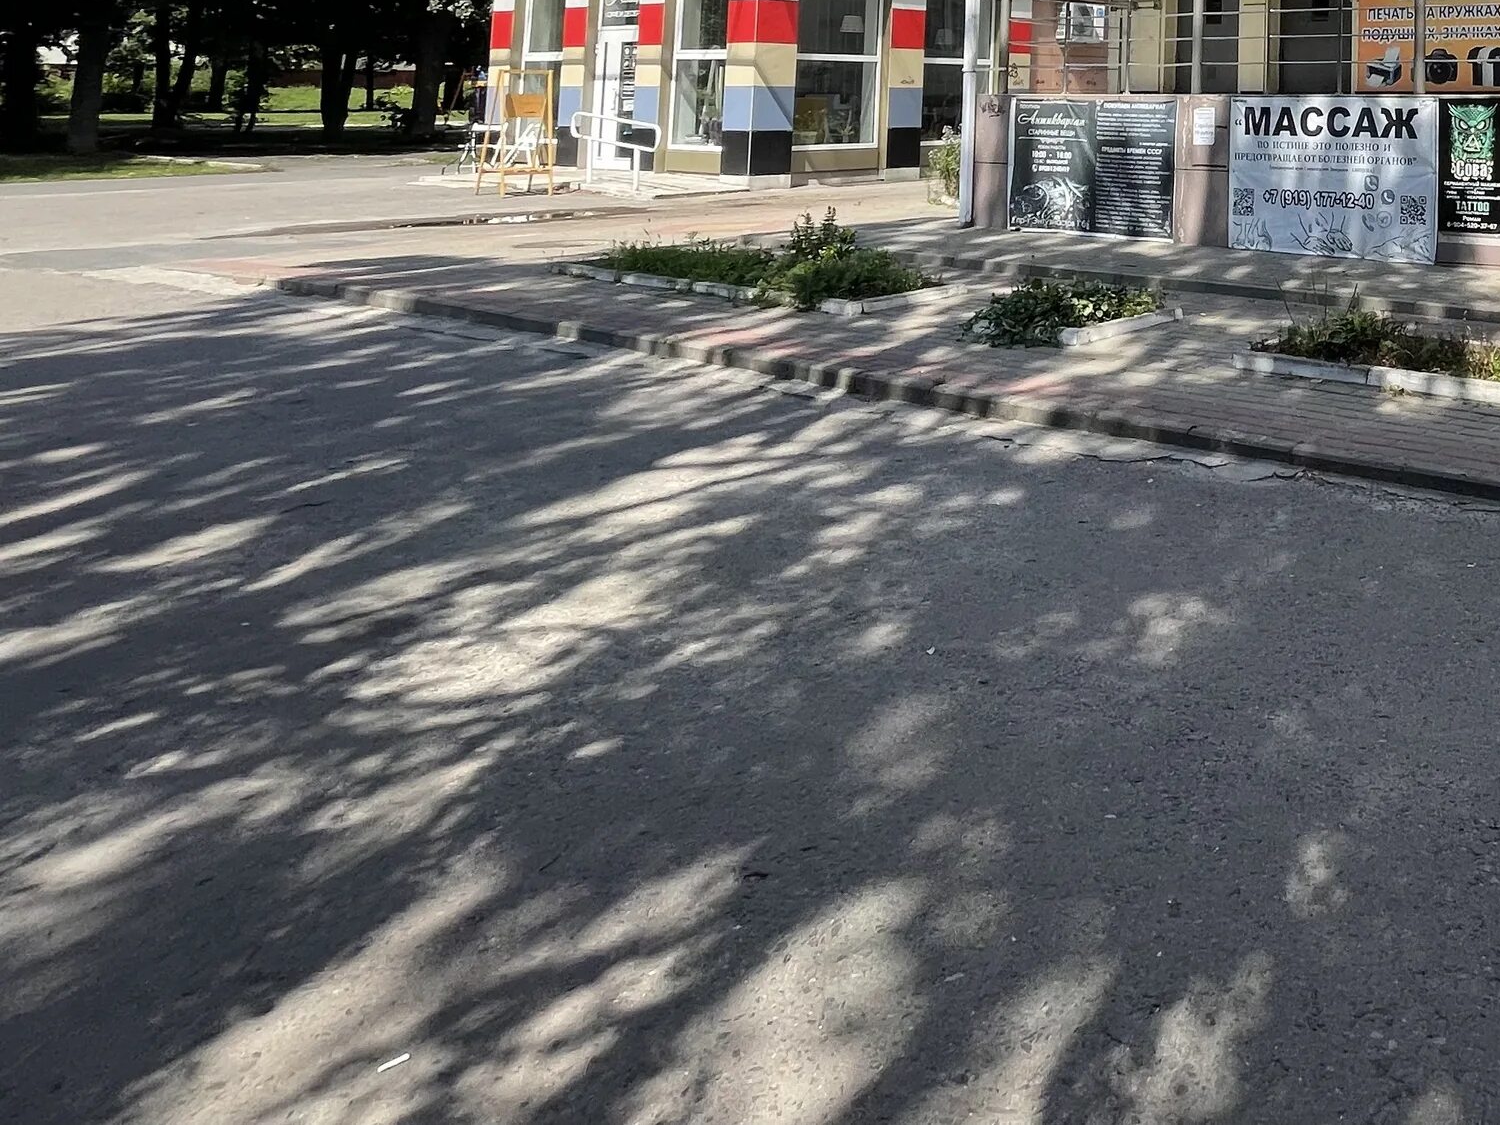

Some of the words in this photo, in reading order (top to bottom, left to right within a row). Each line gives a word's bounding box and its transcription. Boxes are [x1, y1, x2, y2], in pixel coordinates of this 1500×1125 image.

[1368, 7, 1414, 20] ПЕЧАТЬ
[1363, 27, 1440, 43] ПОДУШХ,
[1257, 141, 1269, 149] ПО
[1272, 141, 1309, 150] ИСТИНЕ
[1312, 141, 1331, 150] ЭТО
[1335, 142, 1379, 152] ПОЛЕЗНО
[1383, 144, 1391, 152] И
[1304, 154, 1316, 163] ОТ
[1318, 153, 1365, 164] БОЛЕЗНЕЙ
[1263, 189, 1279, 204] +7
[1280, 190, 1311, 210] (919)
[1314, 190, 1374, 209] 177-12-40
[1456, 201, 1490, 212] TATTOO
